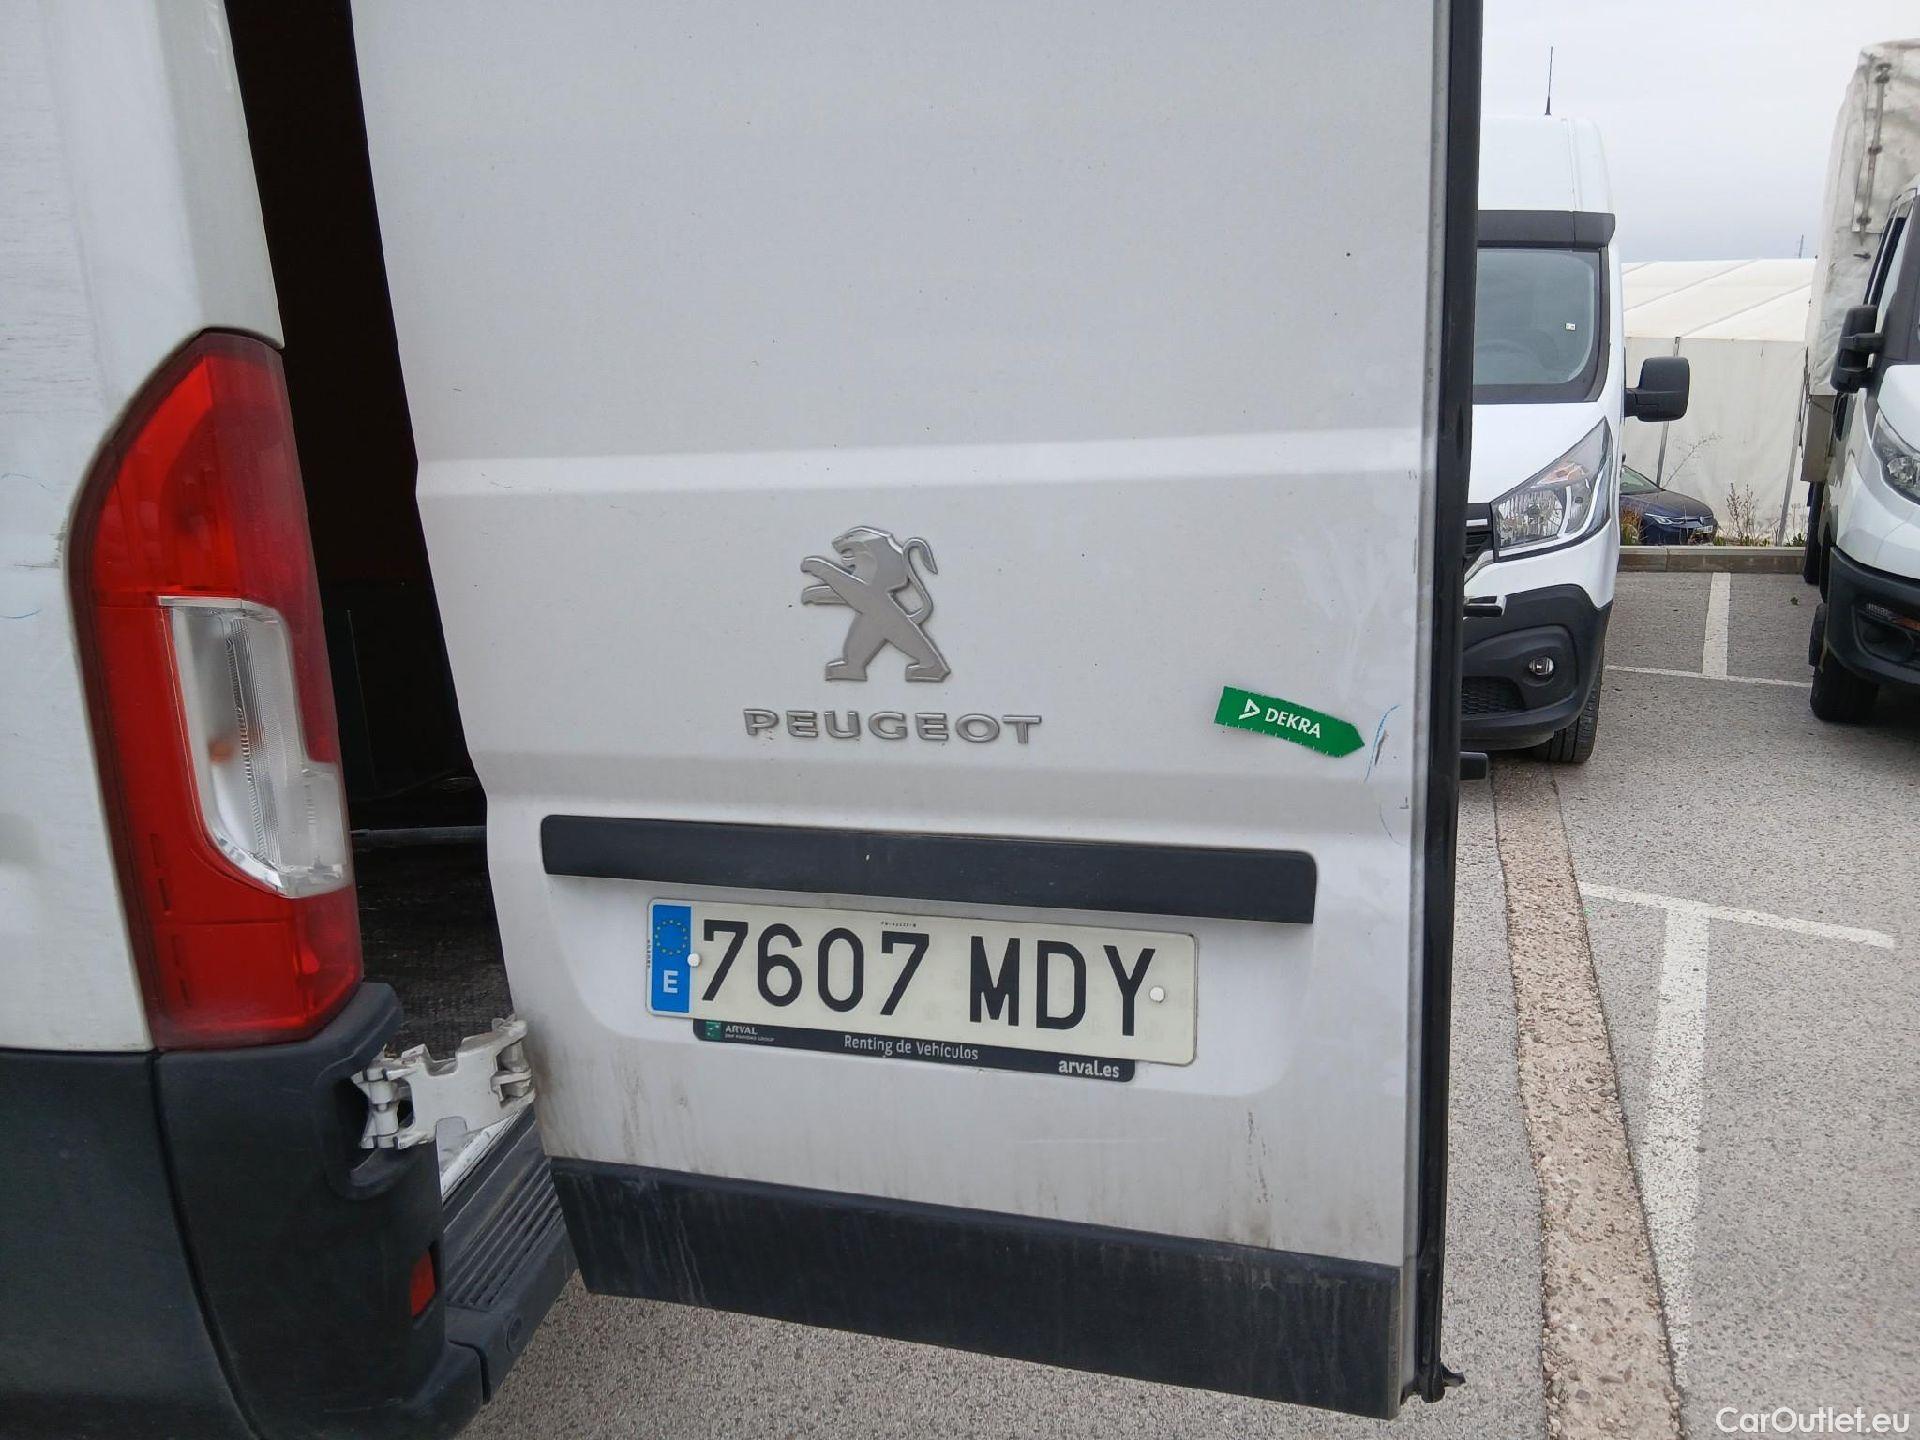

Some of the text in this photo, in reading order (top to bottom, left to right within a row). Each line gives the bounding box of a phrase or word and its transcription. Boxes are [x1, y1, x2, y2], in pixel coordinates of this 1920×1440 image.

[743, 708, 1042, 745] PEUGEOT
[1264, 707, 1321, 739] DEKRA
[663, 970, 679, 993] E
[701, 919, 1156, 1036] 7607 MDY
[725, 1025, 758, 1035] ARVAL
[844, 1035, 979, 1060] Renting de Vehículos
[1058, 1060, 1120, 1079] arval.es
